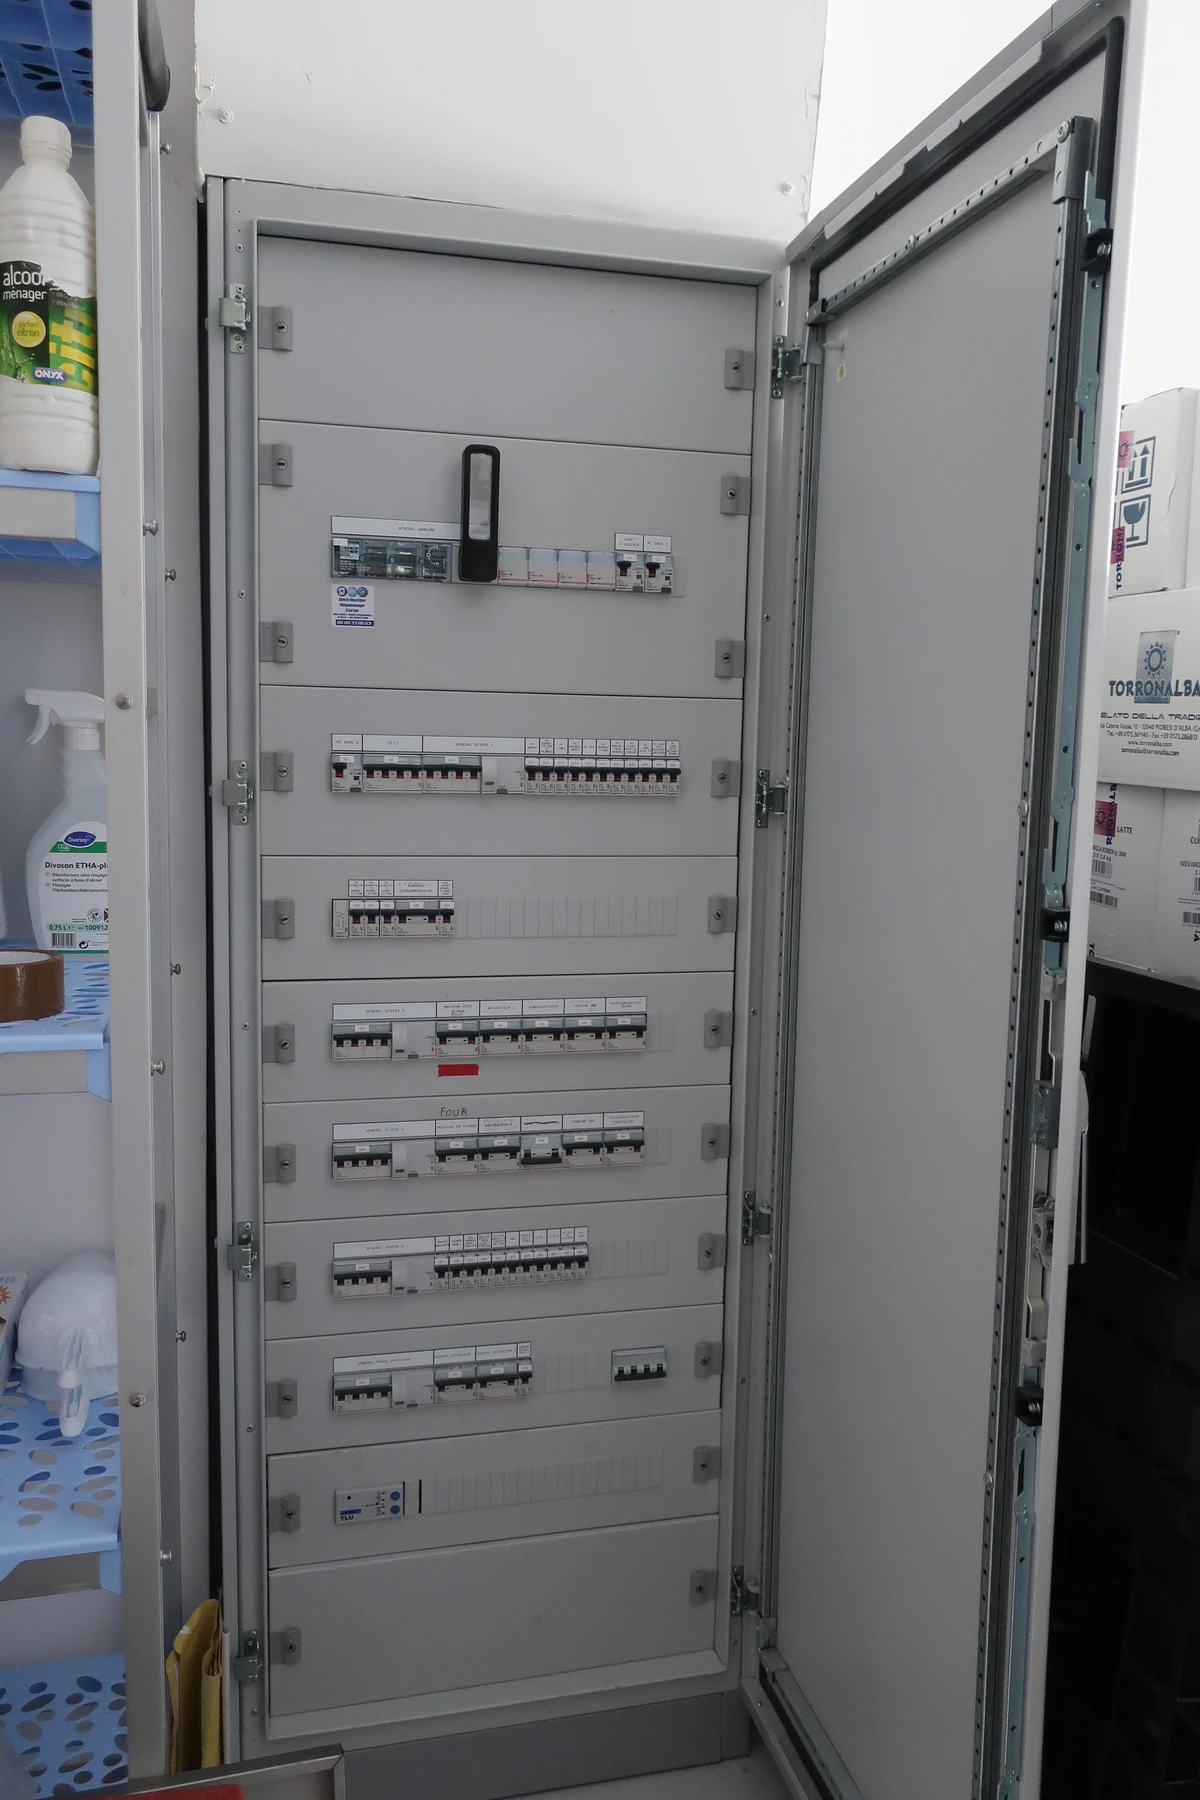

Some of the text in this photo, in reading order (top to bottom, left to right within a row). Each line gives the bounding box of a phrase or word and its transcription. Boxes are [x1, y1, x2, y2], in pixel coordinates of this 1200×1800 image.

[3, 286, 47, 302] ménager
[17, 327, 39, 337] citron
[34, 369, 65, 382] ONYX
[1109, 679, 1200, 697] TORRONALBA
[1128, 740, 1173, 748] www.torronalba.com
[1121, 747, 1180, 756] torronalba@torronalba.com
[1117, 826, 1133, 835] LATTE
[68, 836, 88, 844] Diversey
[75, 862, 108, 870] ETHA-pl
[440, 1106, 468, 1117] FOUR
